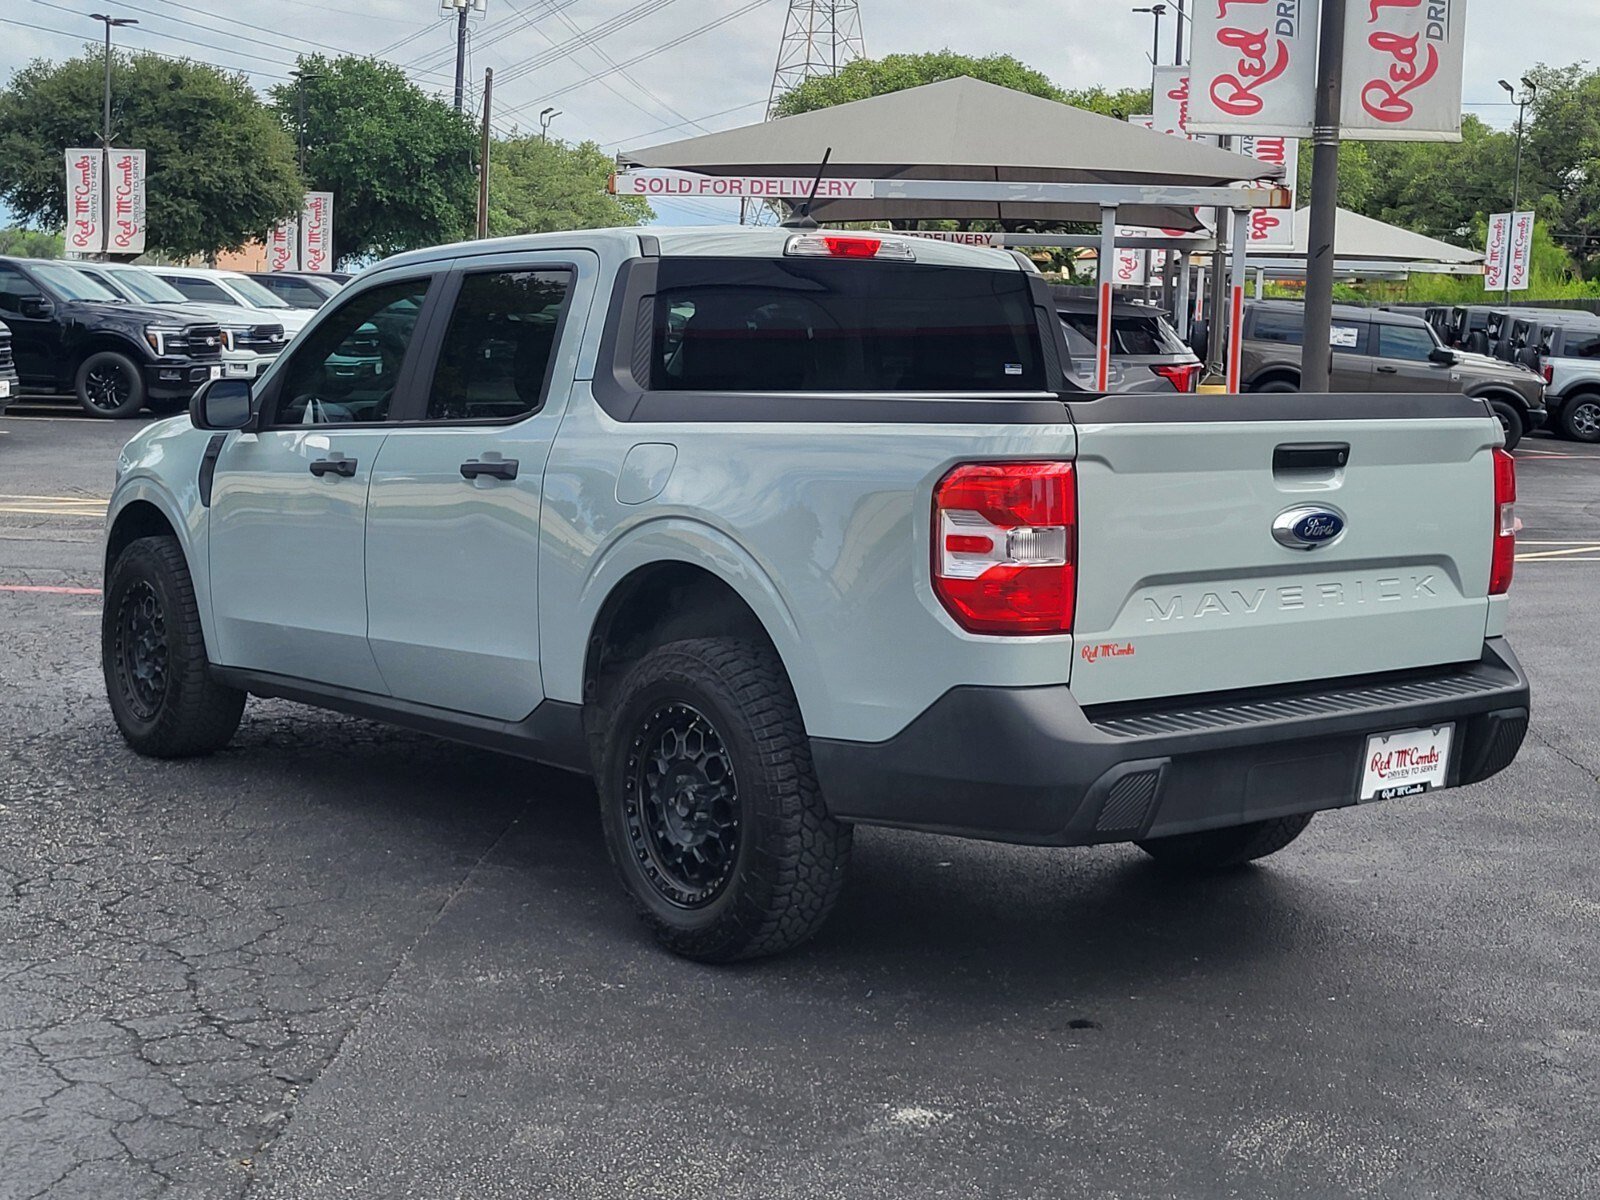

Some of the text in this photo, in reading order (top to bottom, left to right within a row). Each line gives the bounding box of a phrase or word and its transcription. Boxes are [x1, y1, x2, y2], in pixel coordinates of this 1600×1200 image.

[1426, 0, 1446, 41] DRI
[1210, 27, 1289, 116] Red
[1361, 32, 1438, 122] Red
[72, 155, 95, 247] Red McCombs
[91, 181, 97, 192] TO
[115, 155, 137, 247] Red McCombs
[133, 181, 139, 192] TO
[633, 178, 858, 196] SOLD FOR DELIVERY
[307, 197, 326, 271] Red McCombs
[1511, 216, 1527, 285] Red McCombs
[272, 247, 291, 269] Red
[1118, 257, 1138, 279] Red
[1488, 218, 1503, 286] Red McCombs
[1303, 516, 1335, 537] Ford
[1144, 575, 1436, 621] MAVERICK
[1081, 642, 1135, 663] Red McCombs
[1371, 745, 1439, 778] Red McCombs
[1388, 764, 1438, 779] DRIVEN TO SERVE
[1381, 789, 1396, 800] Red
